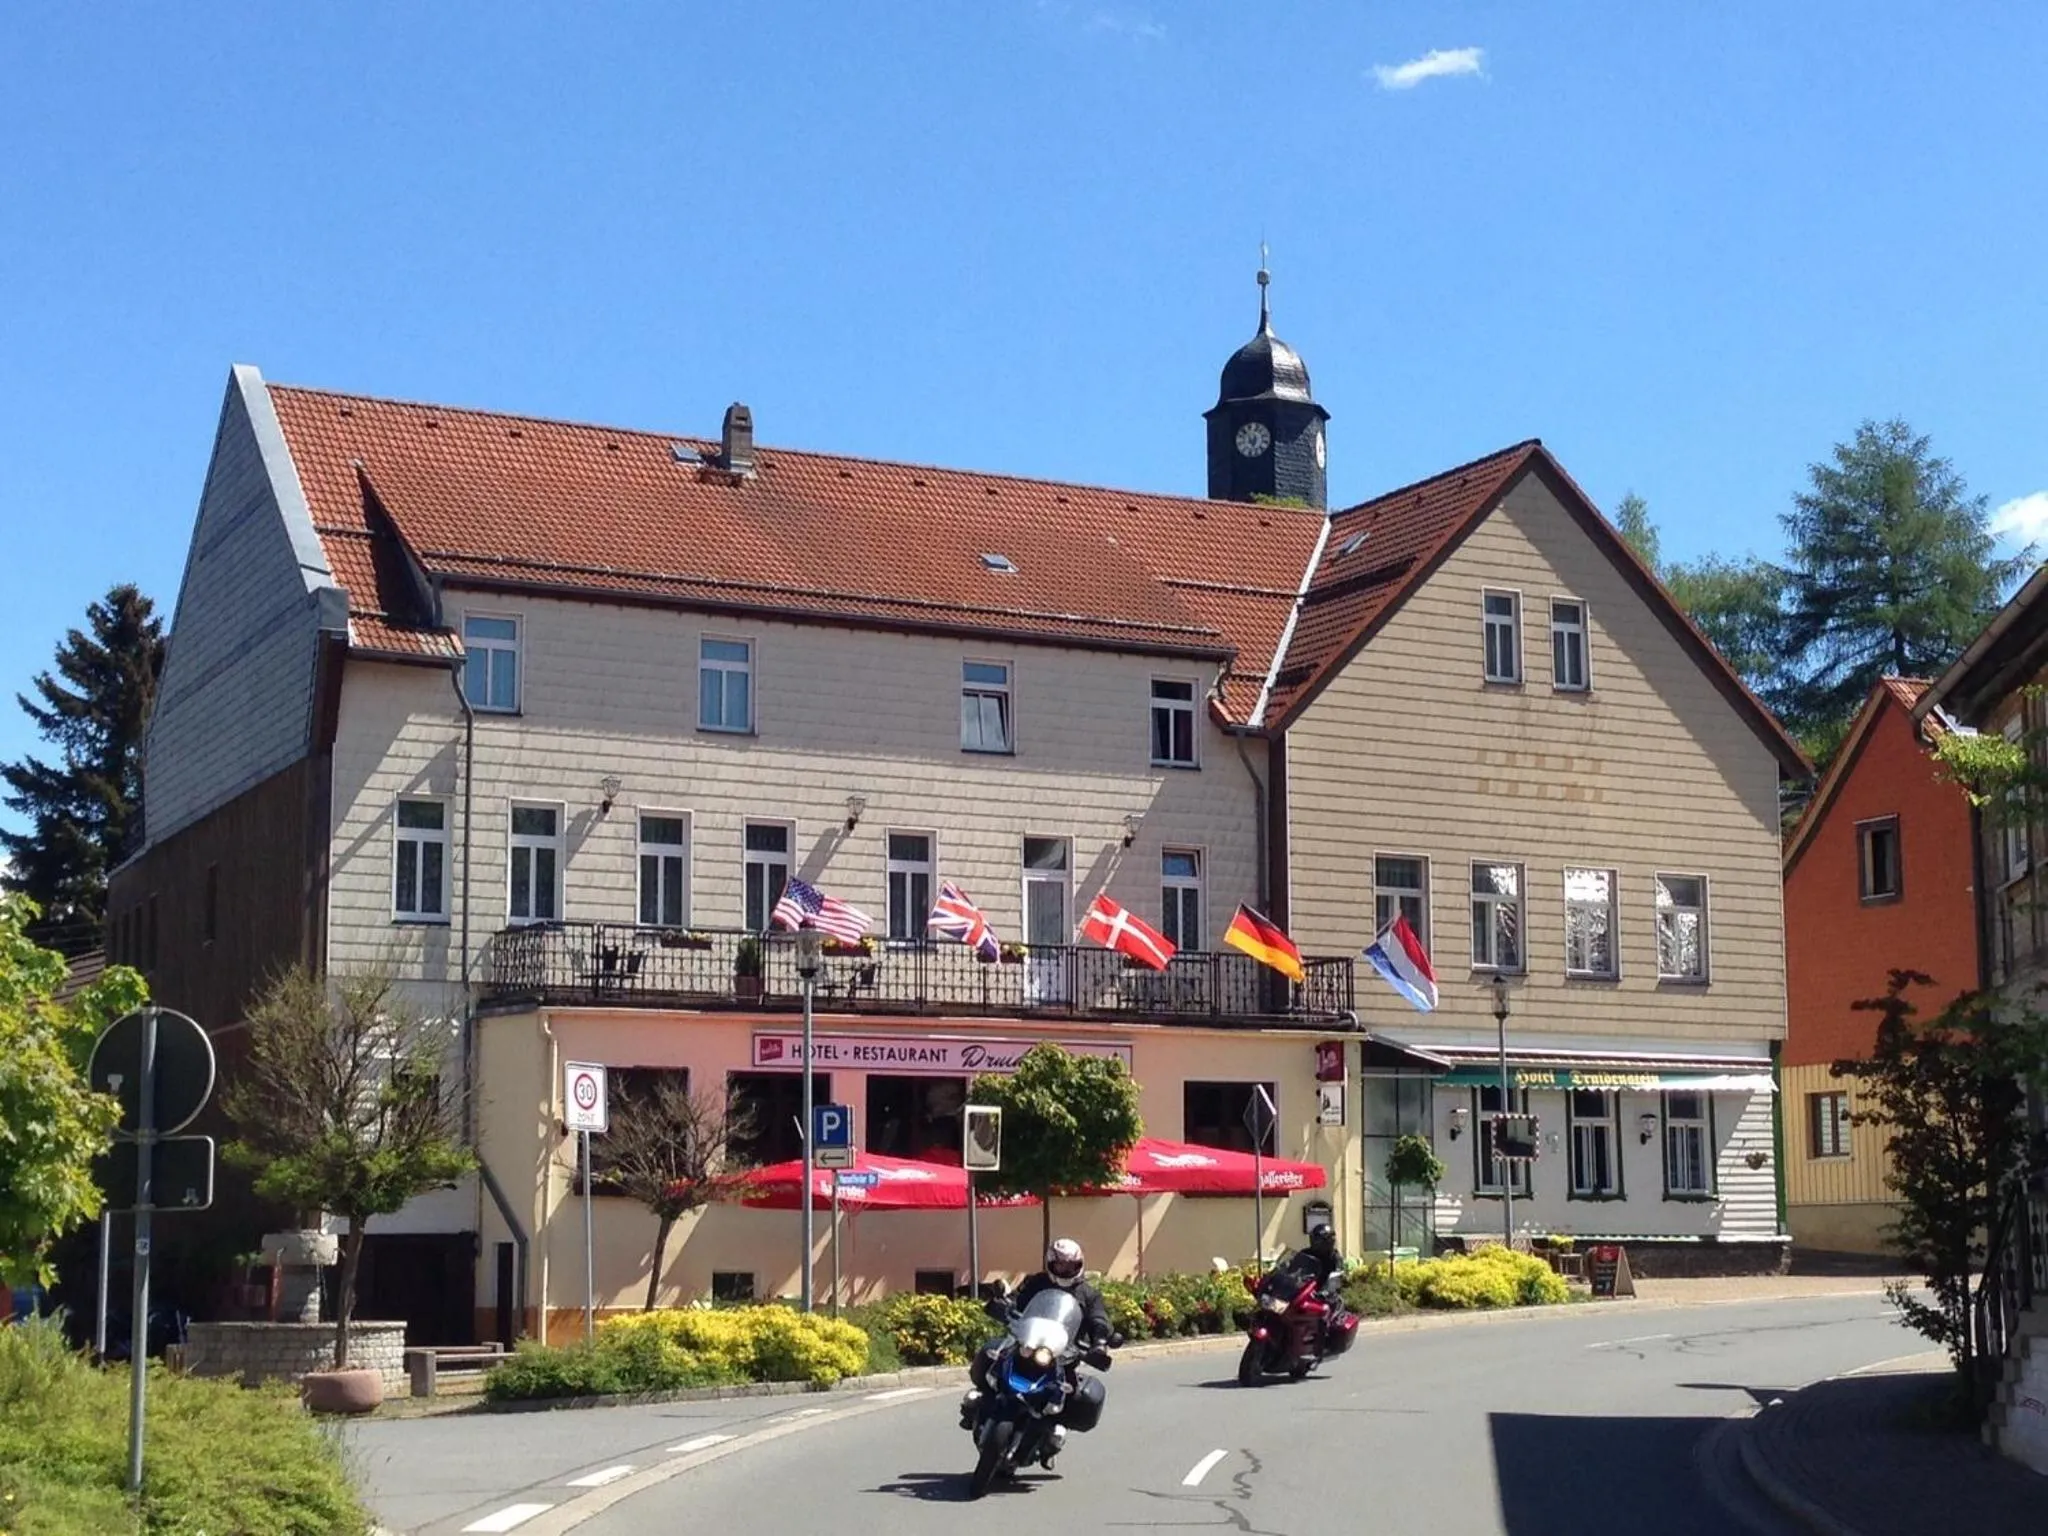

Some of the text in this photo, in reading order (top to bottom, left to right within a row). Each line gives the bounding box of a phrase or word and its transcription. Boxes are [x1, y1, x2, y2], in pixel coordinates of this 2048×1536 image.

[853, 1046, 949, 1064] RESTAURANT
[579, 1083, 593, 1101] 30
[822, 1110, 841, 1142] P
